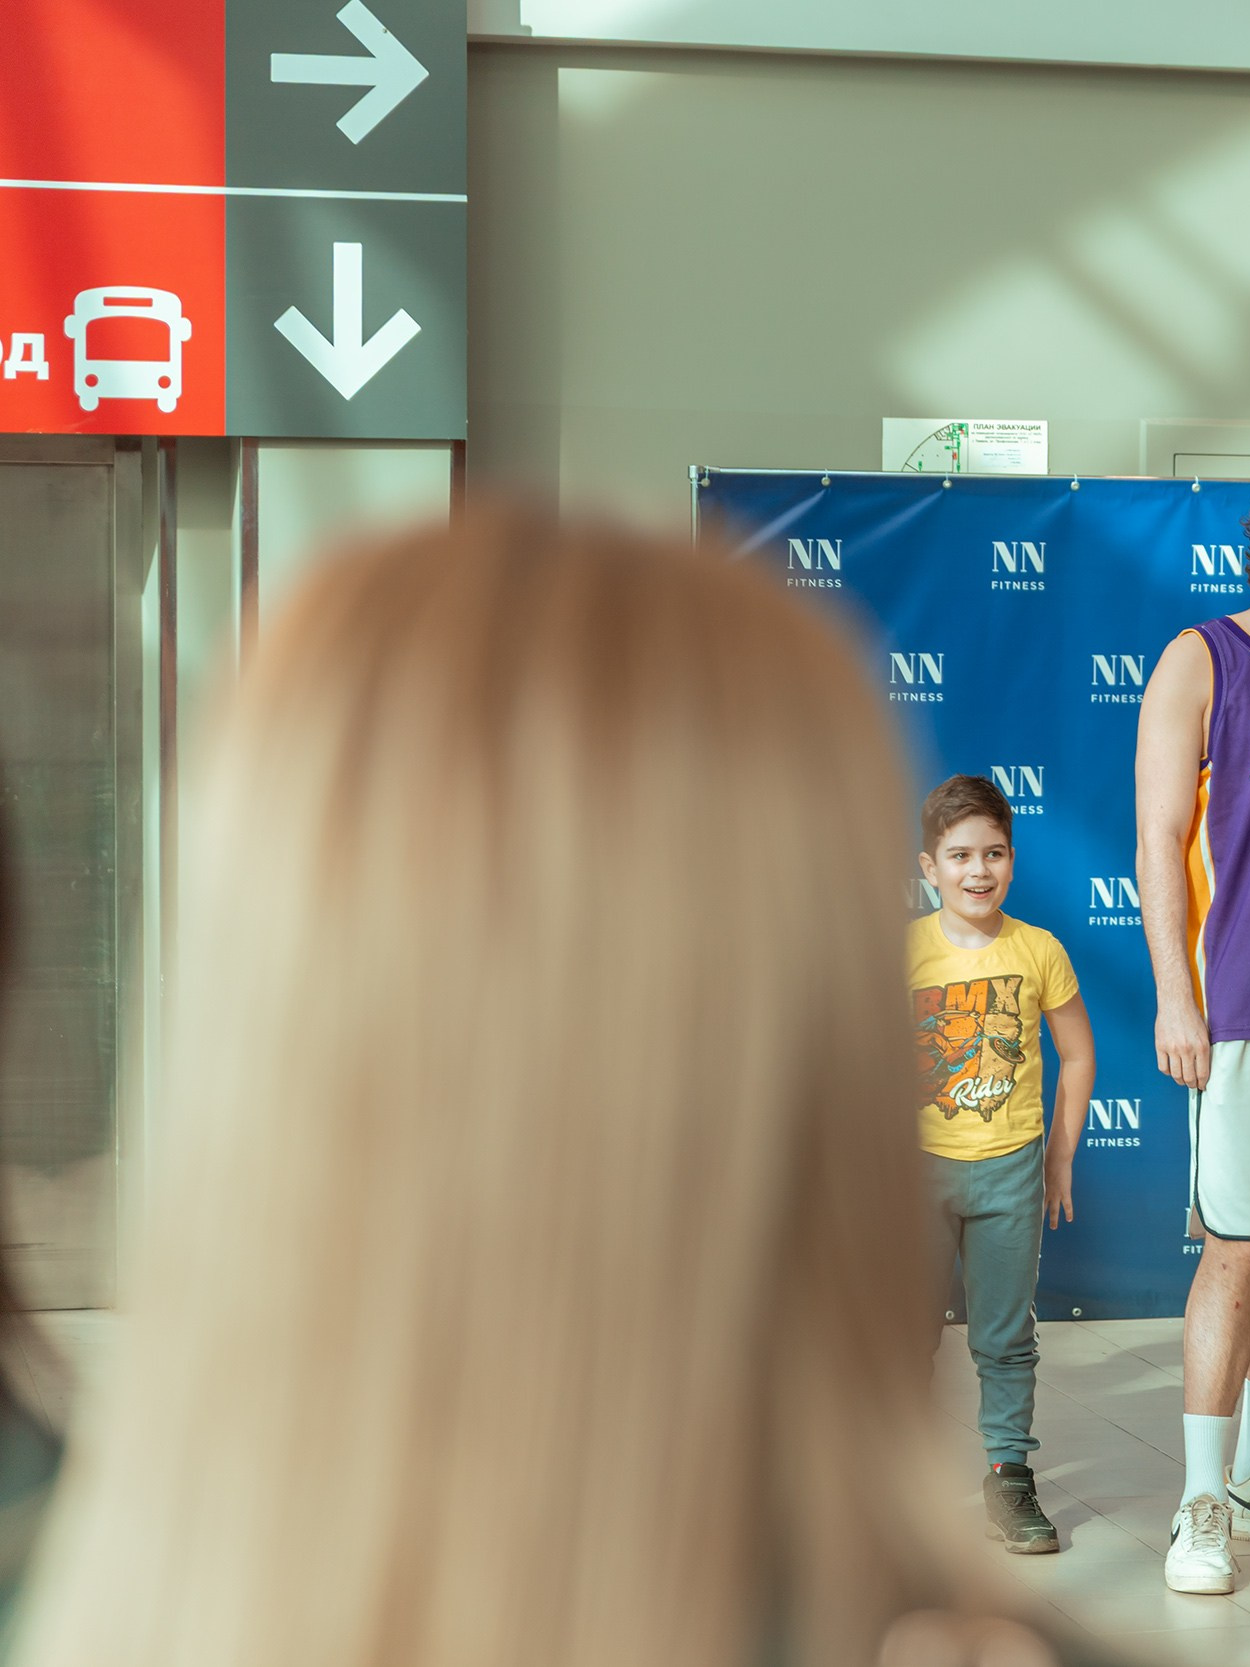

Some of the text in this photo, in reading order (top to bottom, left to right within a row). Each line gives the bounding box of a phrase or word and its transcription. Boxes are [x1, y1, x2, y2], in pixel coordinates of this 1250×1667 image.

[996, 423, 1042, 432] ЭВАКУАЦИИ
[787, 538, 842, 570] NN
[991, 541, 1046, 573] NN
[1191, 544, 1245, 576] NN
[787, 577, 842, 588] FITNESS
[991, 580, 1046, 591] FITNESS
[1190, 583, 1244, 593] FITNESS
[889, 652, 945, 684] NN
[1091, 654, 1145, 686] NN
[889, 692, 944, 702] FITNESS
[1090, 694, 1143, 703] FITNESS
[990, 765, 1045, 797] NN
[1010, 805, 1044, 815] NESS
[1089, 877, 1141, 909] NN
[1089, 916, 1142, 926] FITNESS
[949, 1076, 1014, 1107] Rider
[1087, 1099, 1141, 1130] NN
[1087, 1137, 1141, 1148] FITNESS
